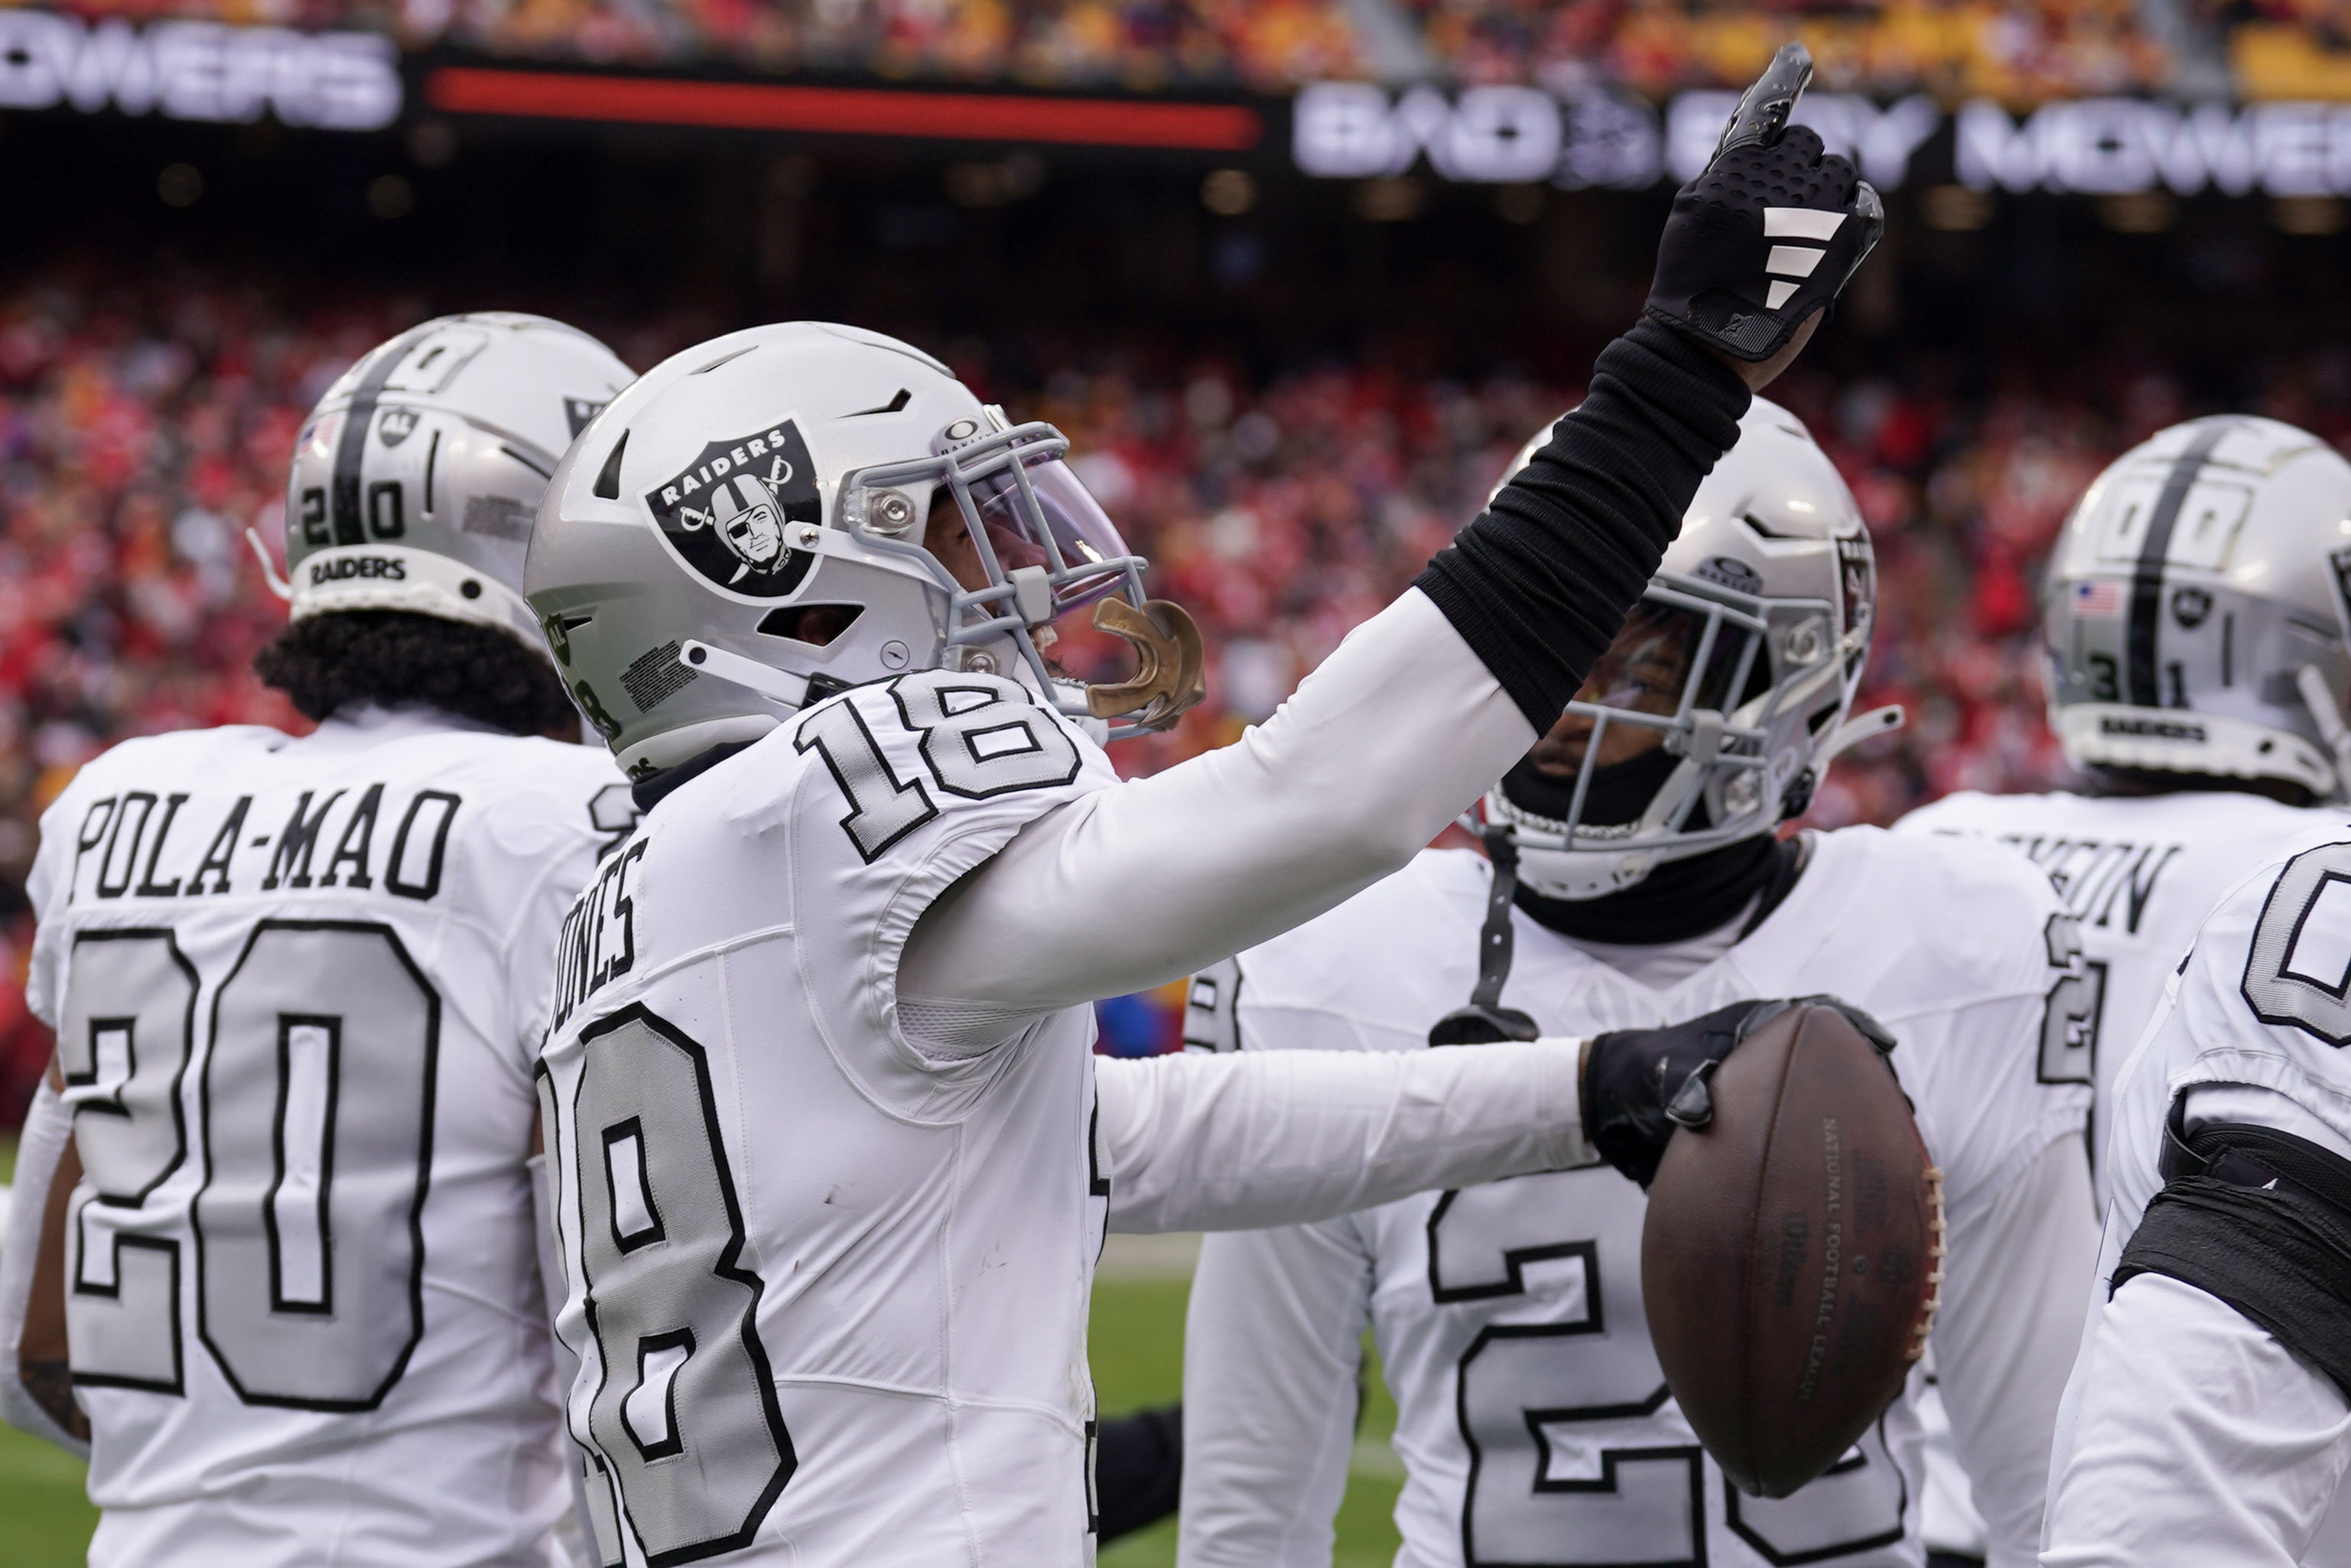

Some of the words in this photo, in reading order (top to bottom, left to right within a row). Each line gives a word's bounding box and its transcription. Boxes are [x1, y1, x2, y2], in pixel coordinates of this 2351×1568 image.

[1293, 83, 1562, 182] BAD
[1953, 95, 2351, 197] MOWE
[303, 480, 405, 545] 20
[661, 429, 785, 506] RAIDERS
[311, 558, 406, 587] RAIDERS
[2089, 652, 2192, 710] 31
[792, 668, 1082, 865] 18
[68, 783, 462, 906] POLA-MAO
[61, 918, 441, 1413] 20
[1822, 1116, 1842, 1213] NATIONAL
[1816, 1221, 1842, 1326] FOOTBALL
